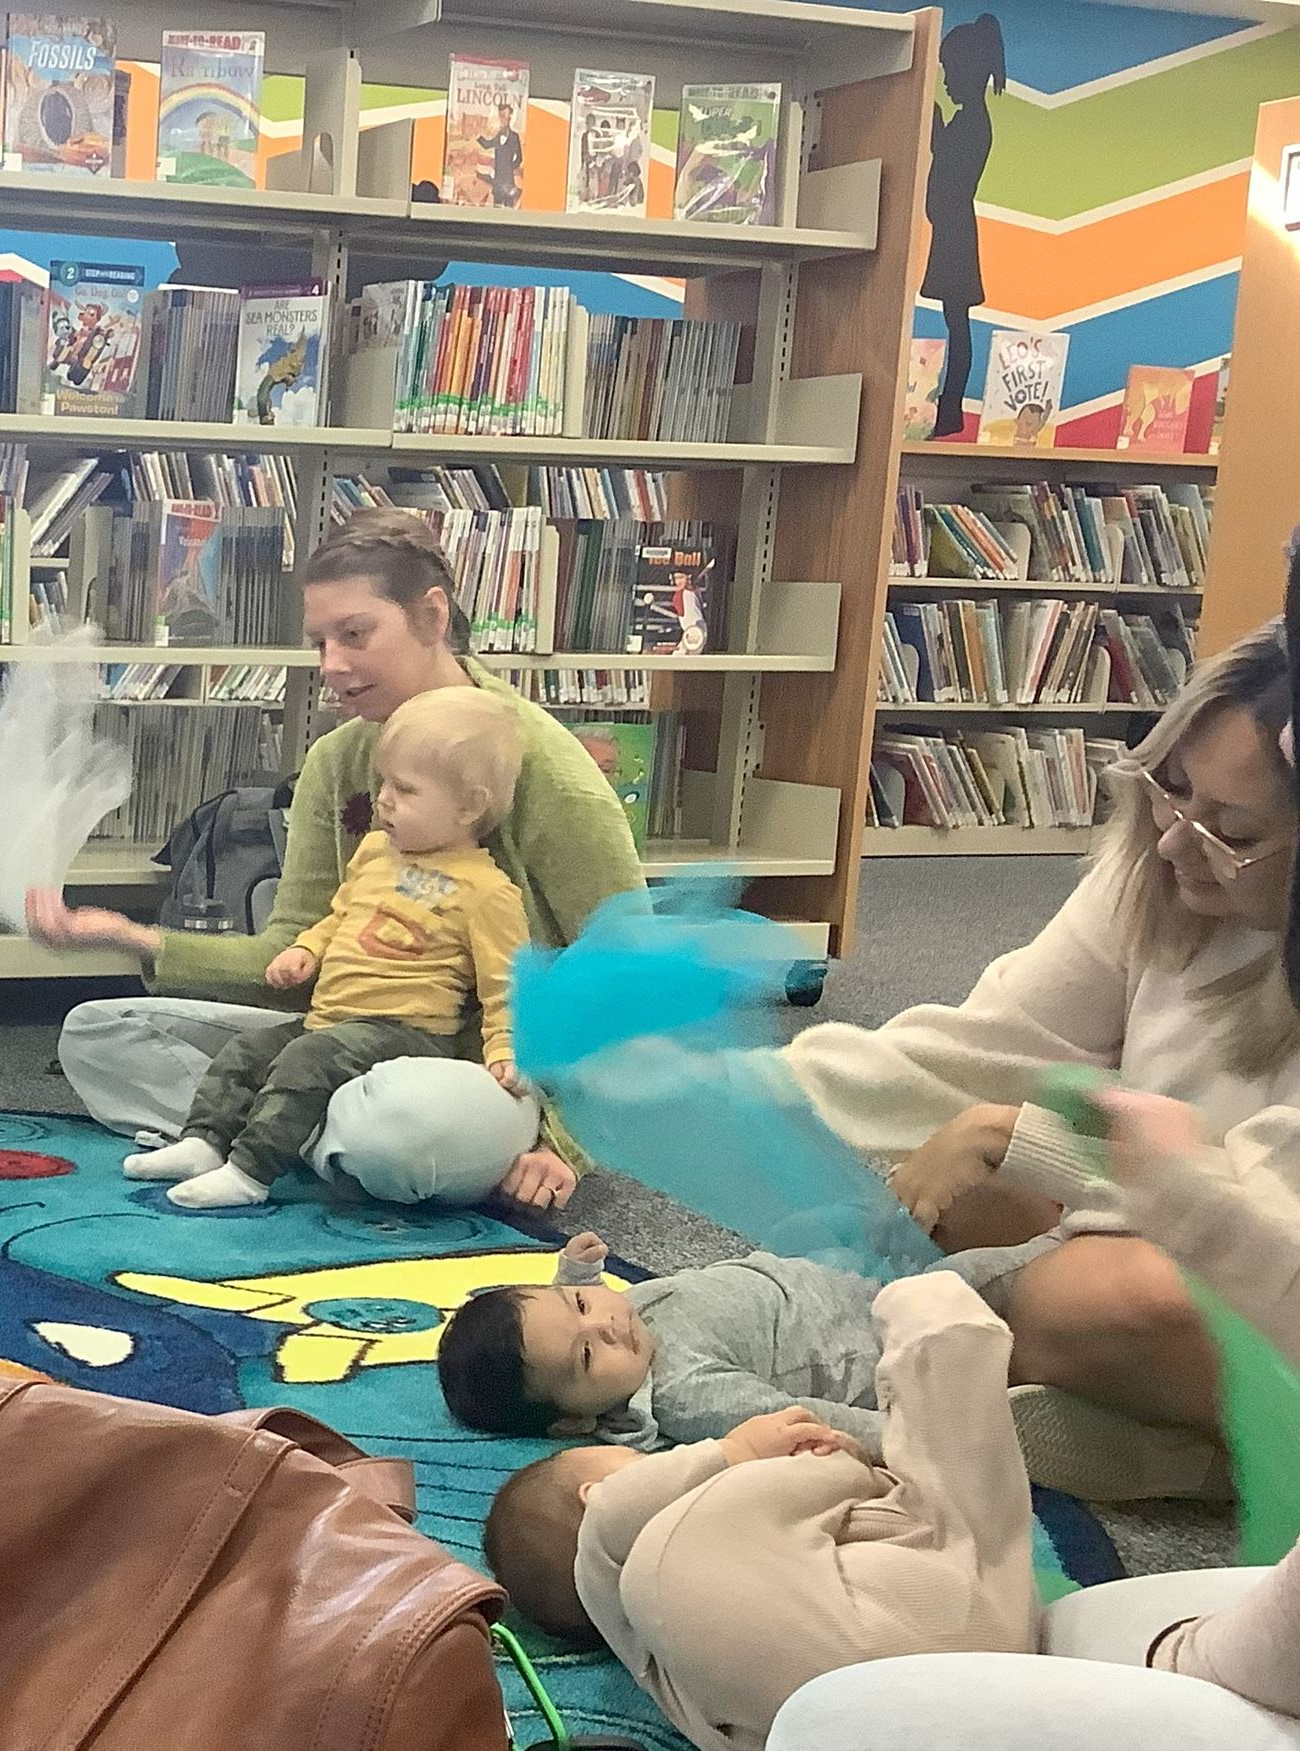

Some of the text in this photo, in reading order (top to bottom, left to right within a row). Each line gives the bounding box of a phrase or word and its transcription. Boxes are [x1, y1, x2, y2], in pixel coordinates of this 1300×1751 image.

[29, 40, 97, 71] FOSSILS
[457, 87, 523, 109] LINCOLN
[699, 106, 733, 118] UPER
[66, 267, 75, 280] 2
[311, 285, 320, 296] 4
[245, 310, 318, 325] SEA MONSTERS
[266, 324, 296, 337] REAL?
[998, 336, 1043, 371] LEO'S
[1001, 360, 1046, 393] FIRST
[1003, 380, 1049, 412] VOTE!
[674, 551, 702, 567] Ball
